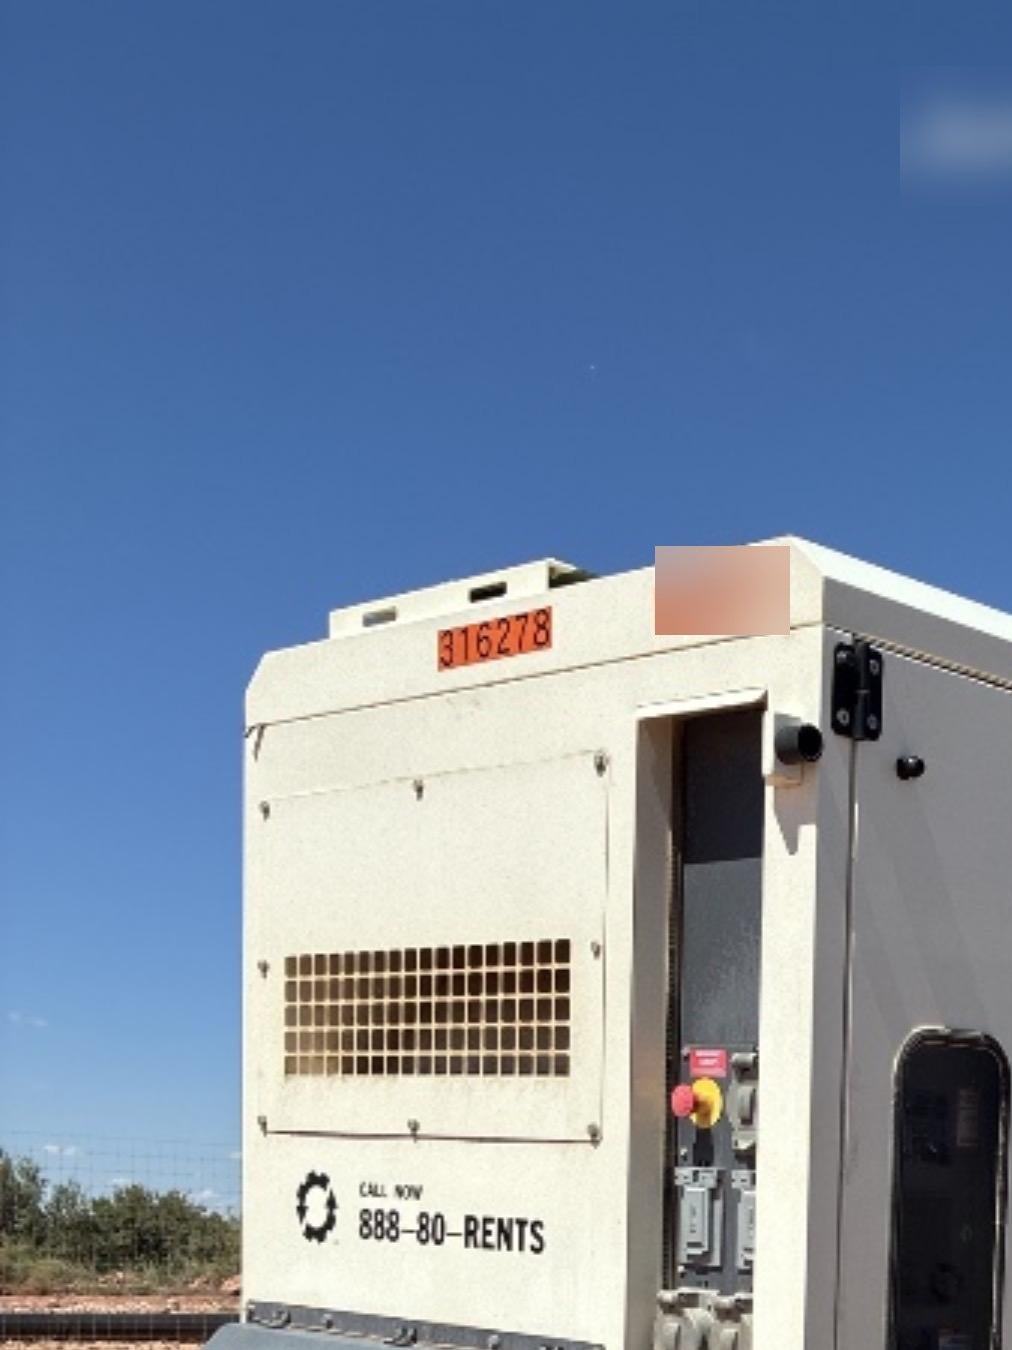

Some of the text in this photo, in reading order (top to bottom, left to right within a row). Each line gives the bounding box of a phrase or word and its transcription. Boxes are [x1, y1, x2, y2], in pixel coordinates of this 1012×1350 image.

[439, 608, 551, 668] 316278
[358, 1181, 424, 1201] CALL NOW
[358, 1208, 546, 1255] 888-80-RENTS
